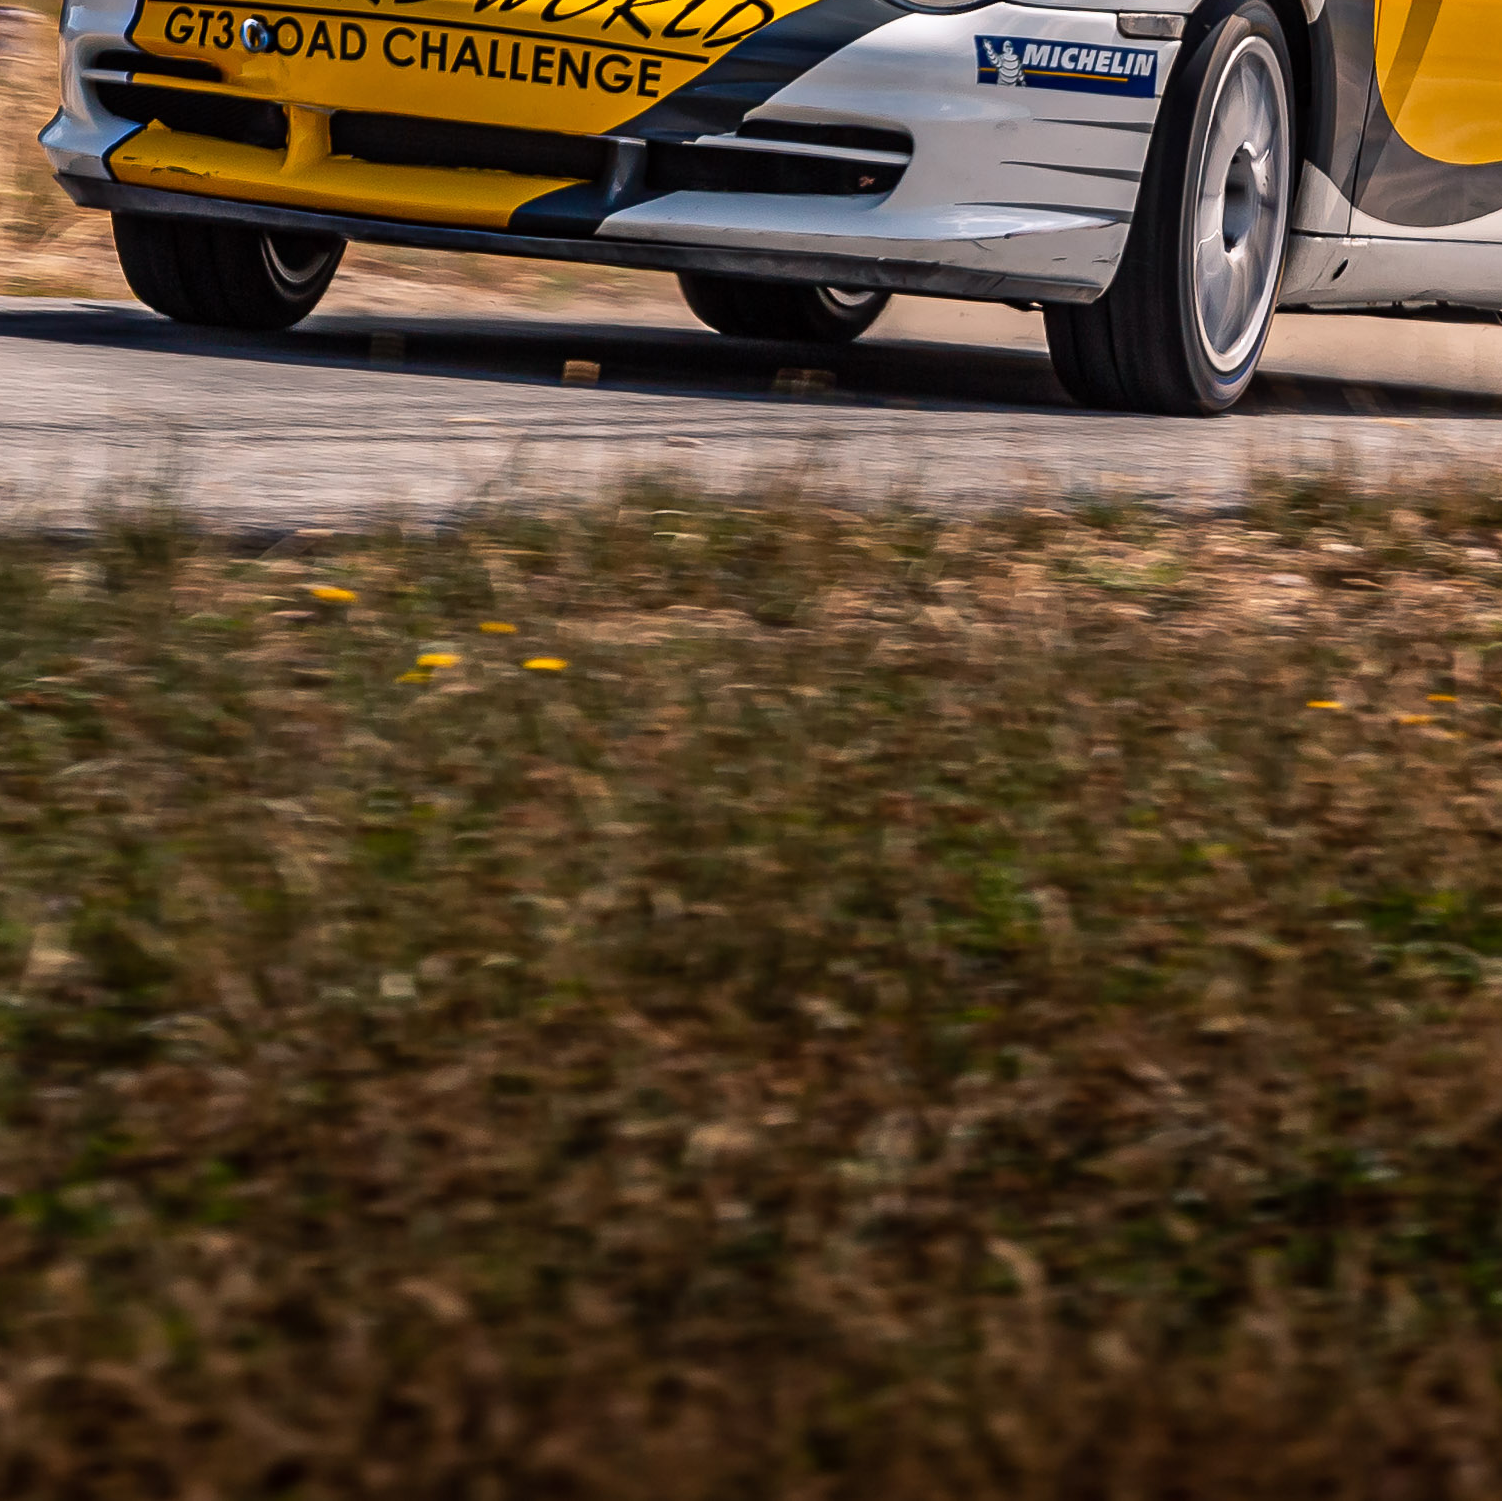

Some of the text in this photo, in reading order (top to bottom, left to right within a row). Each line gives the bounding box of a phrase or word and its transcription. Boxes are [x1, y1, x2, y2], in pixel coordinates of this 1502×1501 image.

[164, 6, 234, 49] GT3
[383, 26, 662, 98] CHALLENGE
[1022, 43, 1155, 76] MICHELIN
